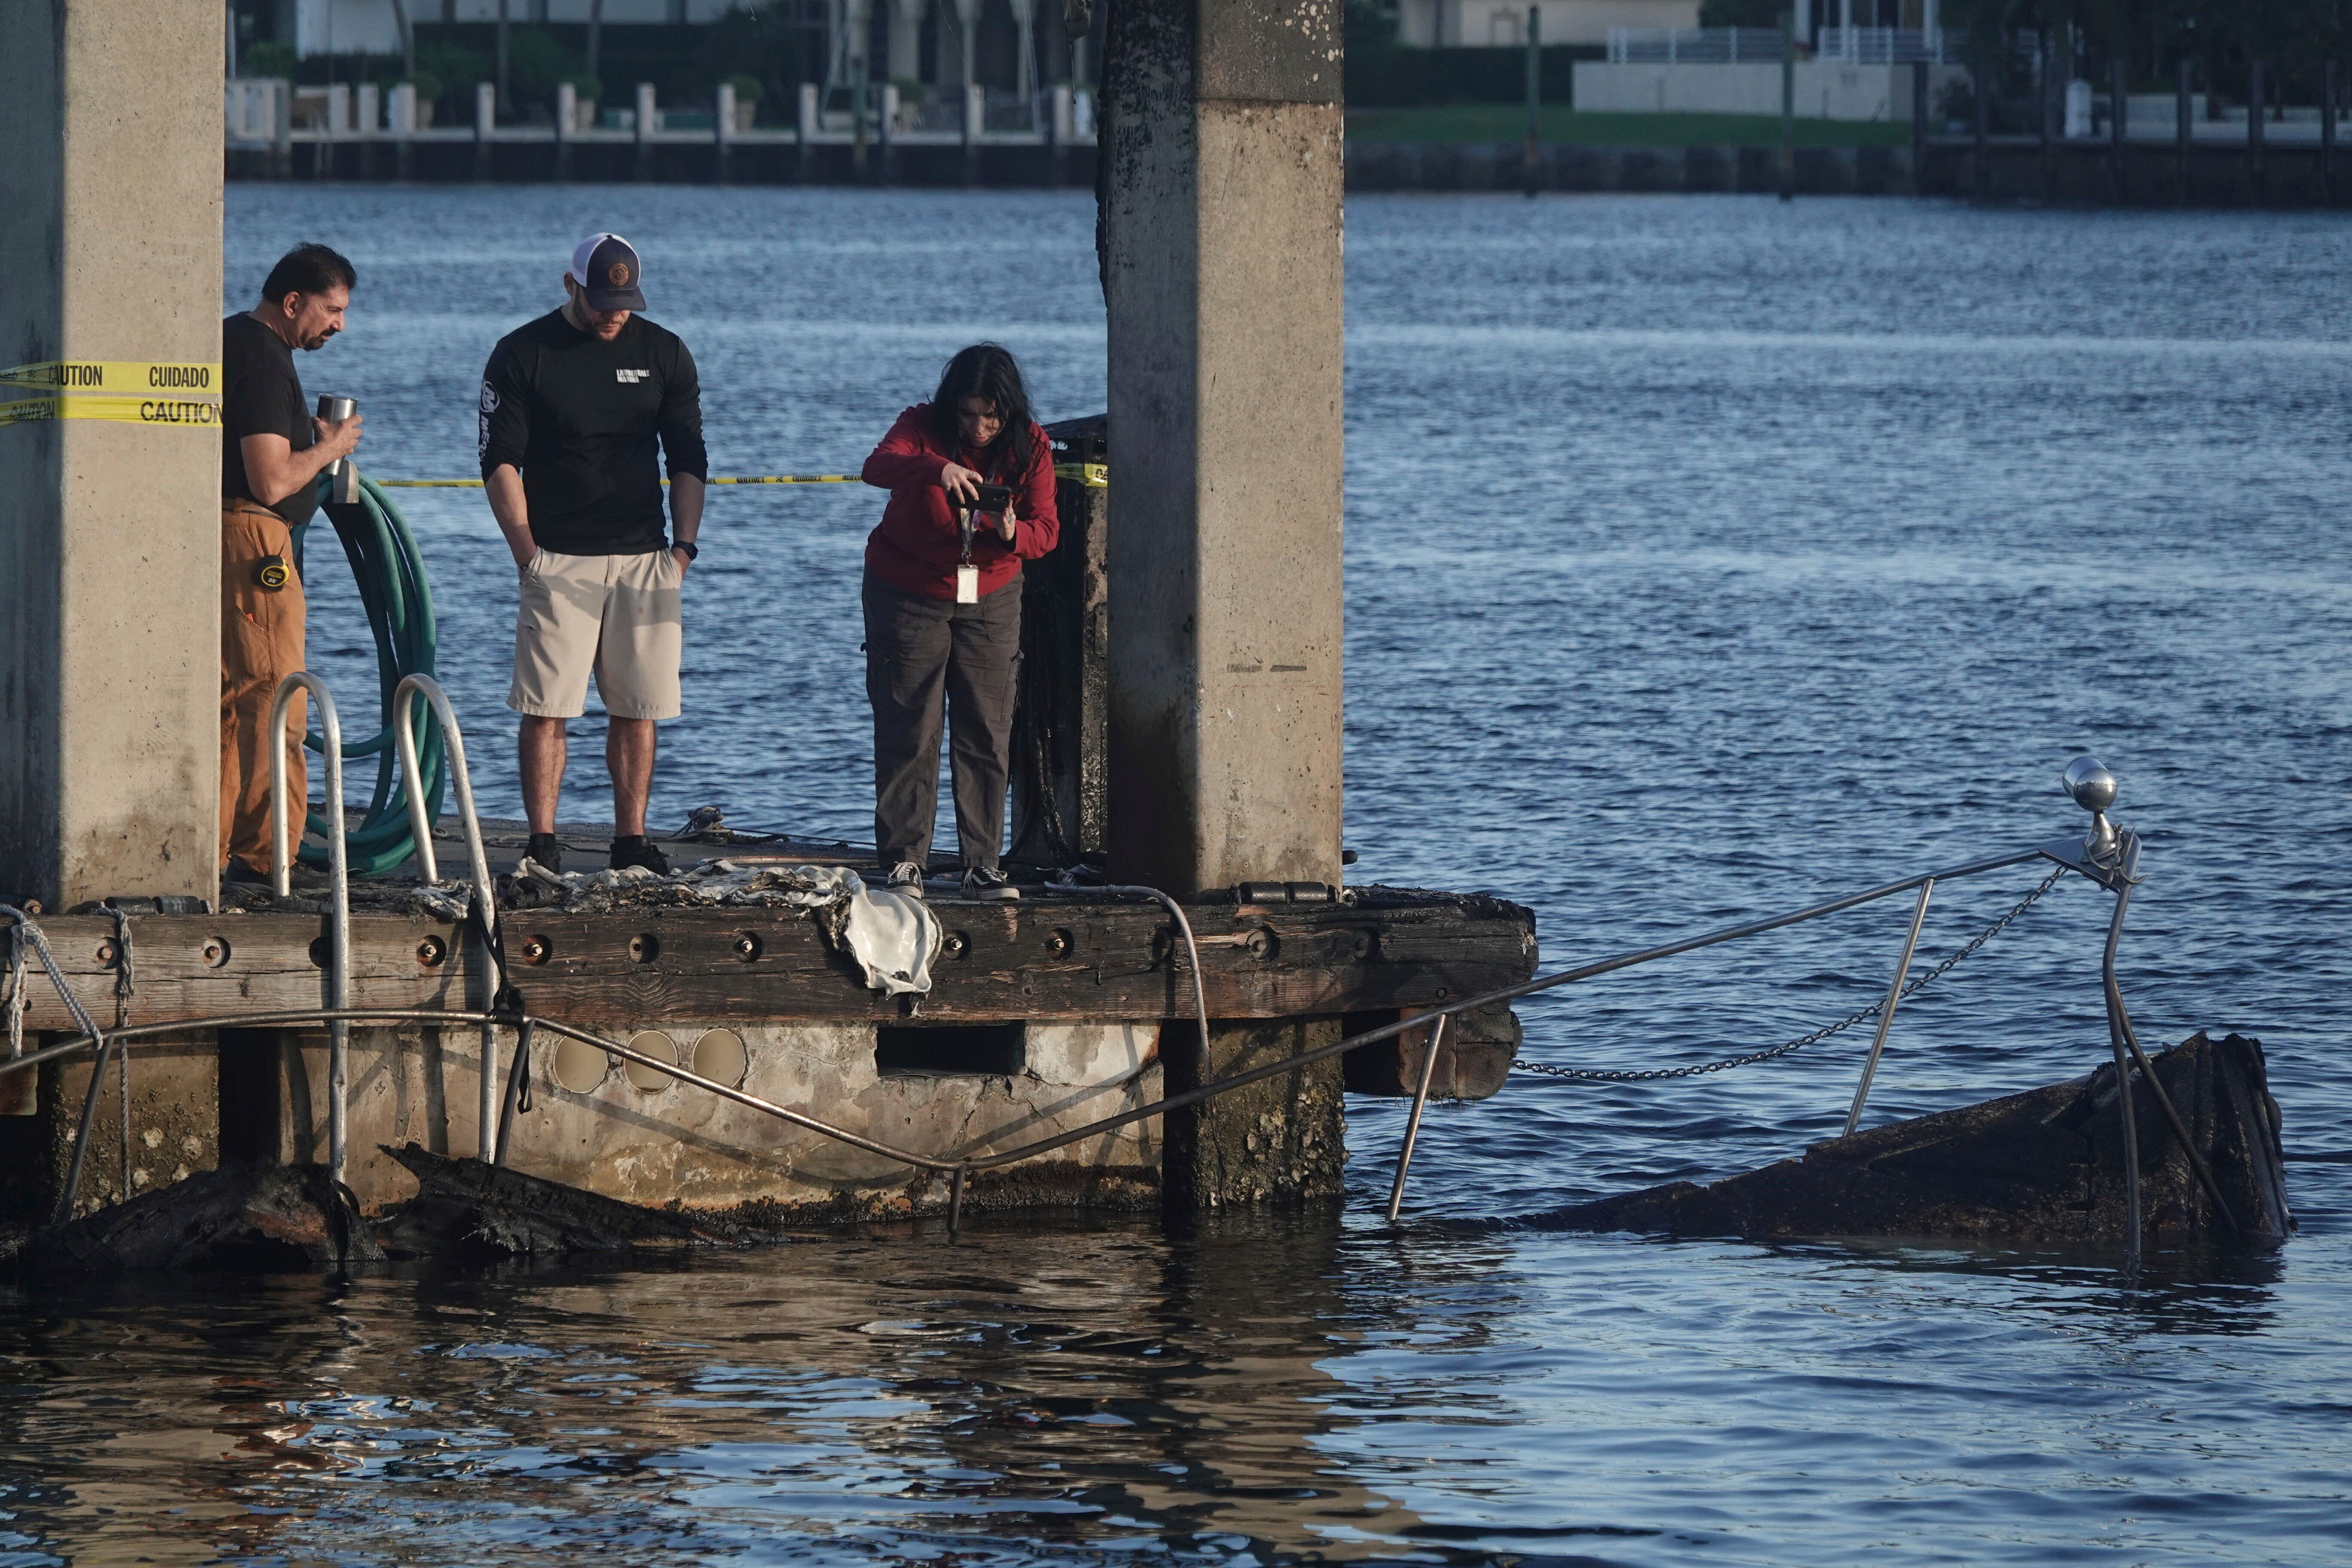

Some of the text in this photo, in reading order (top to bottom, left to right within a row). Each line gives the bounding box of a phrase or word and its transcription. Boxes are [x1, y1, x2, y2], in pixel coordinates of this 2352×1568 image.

[49, 365, 102, 386] CAUTION
[150, 367, 209, 388] CUIDADO
[141, 401, 223, 423] CAUTION
